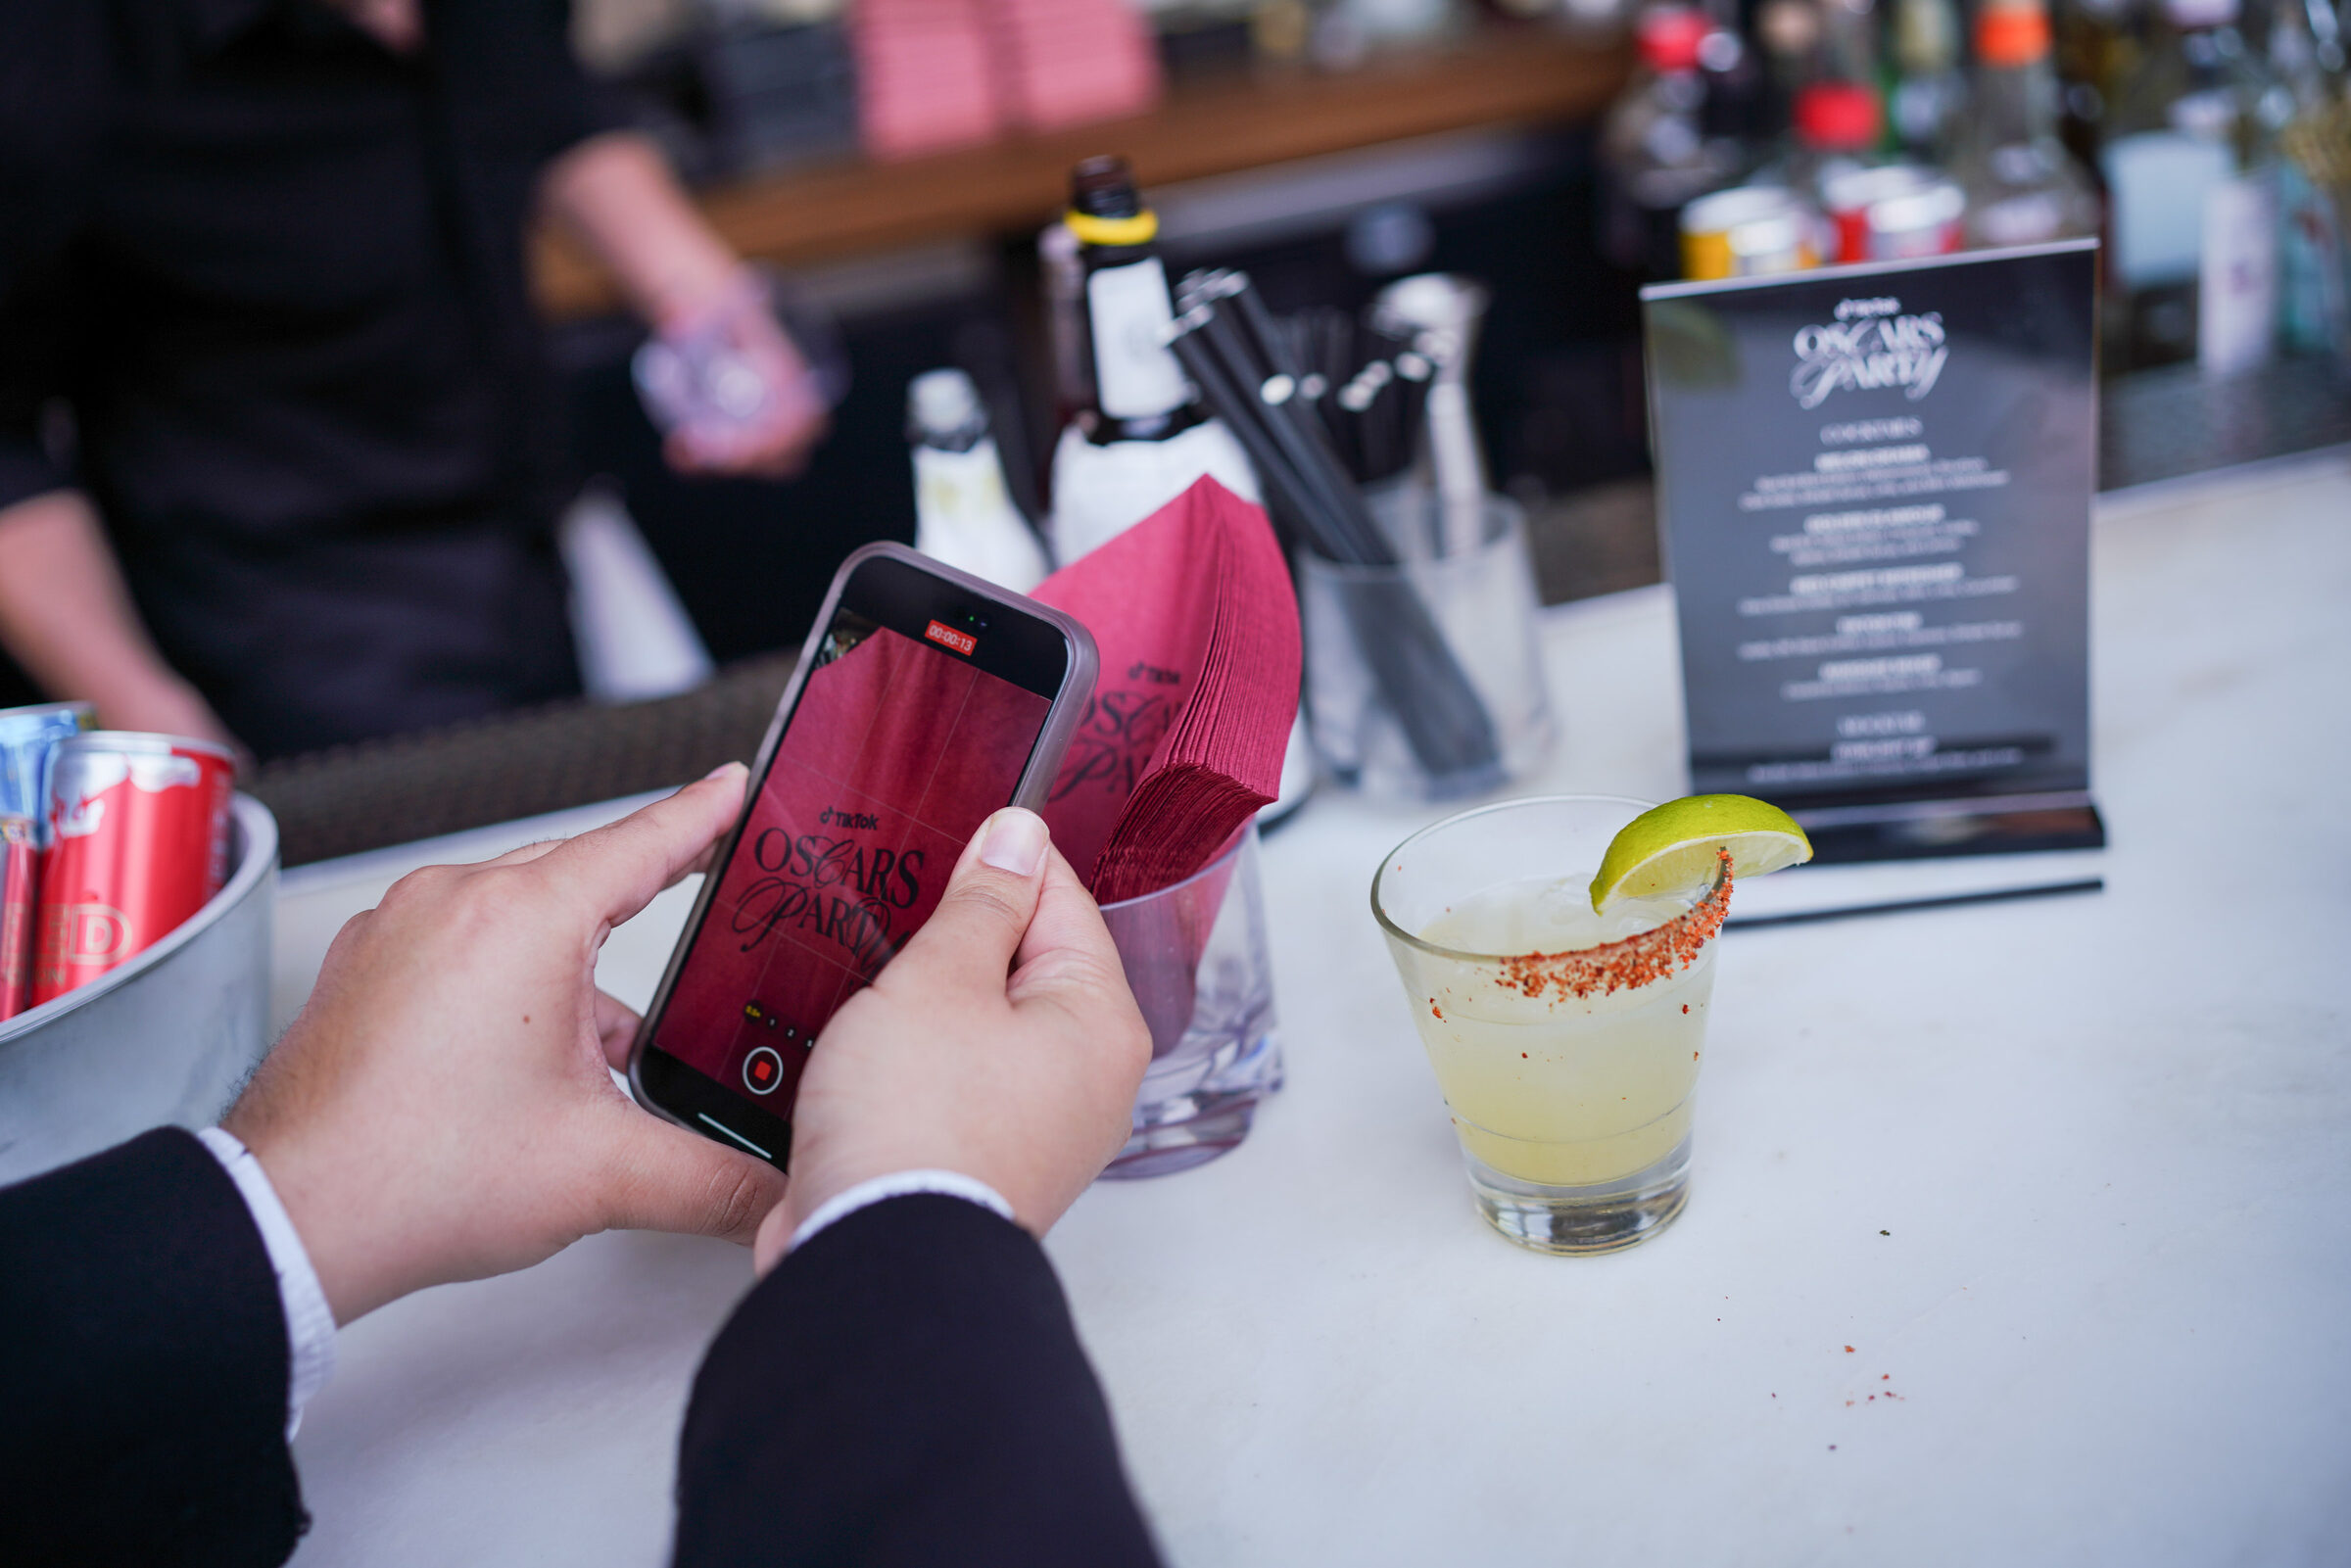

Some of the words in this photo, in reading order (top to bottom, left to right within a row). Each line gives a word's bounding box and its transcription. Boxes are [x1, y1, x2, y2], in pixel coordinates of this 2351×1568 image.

[1793, 311, 1945, 363] OSCARS
[1789, 345, 1949, 410] PARTY
[928, 624, 973, 652] 00:00:13
[836, 811, 880, 831] TikTok
[754, 827, 925, 910] OSCARS
